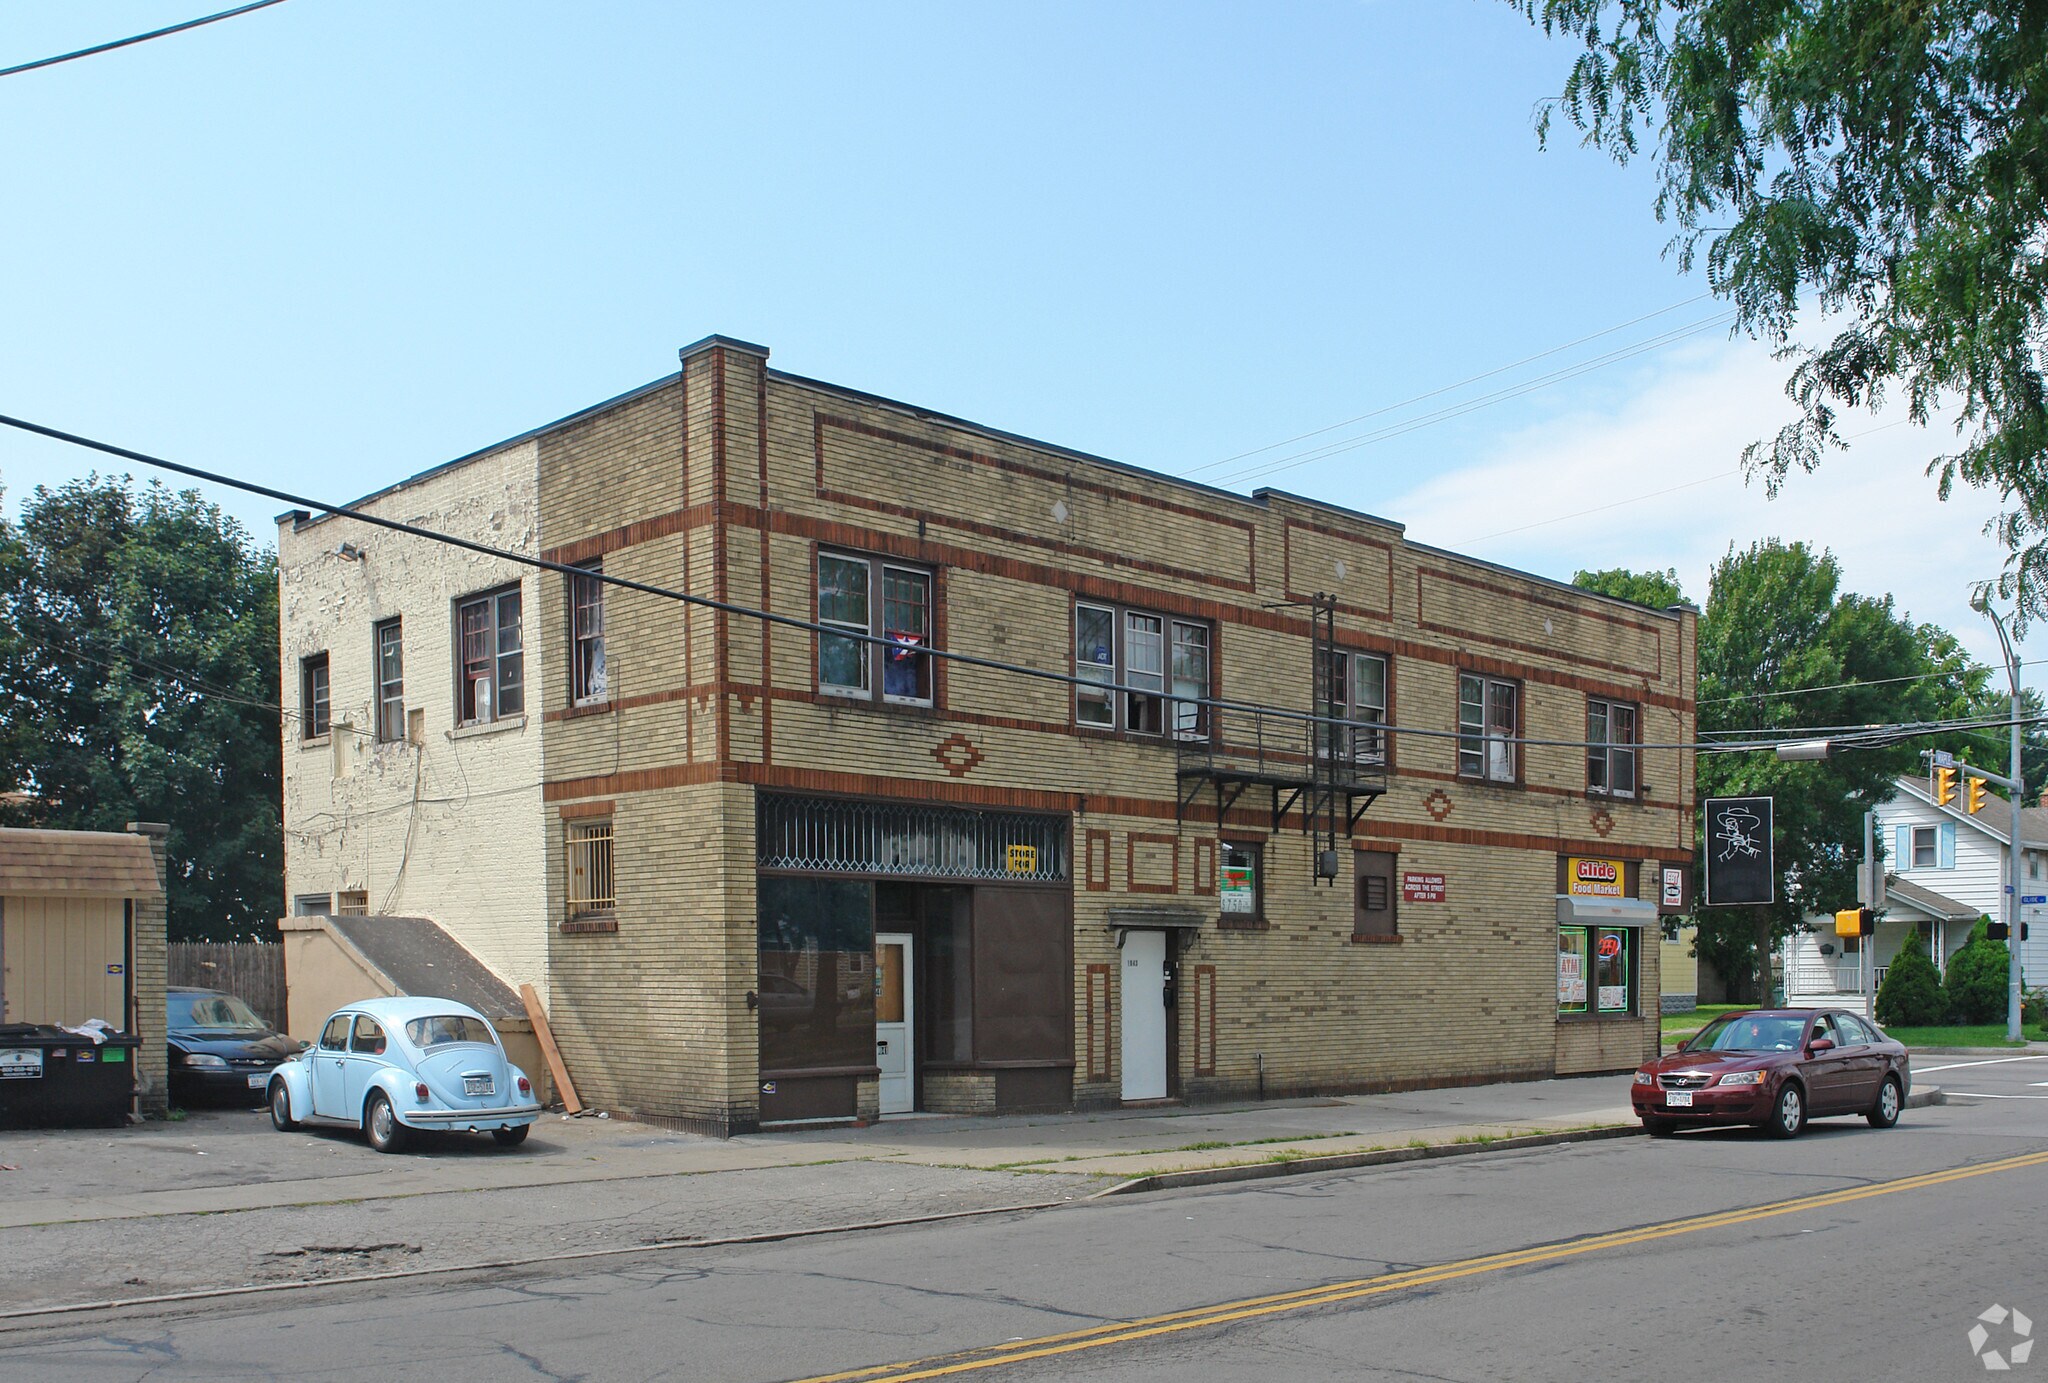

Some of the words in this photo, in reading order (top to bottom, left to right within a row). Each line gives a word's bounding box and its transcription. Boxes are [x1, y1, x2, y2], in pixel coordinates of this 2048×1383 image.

[1009, 849, 1035, 858] STORE
[1015, 859, 1030, 868] FOR
[1577, 860, 1616, 880] Glide
[1425, 876, 1442, 884] ALLOWED
[1573, 882, 1592, 894] Food
[1593, 883, 1620, 895] Market
[1561, 958, 1578, 974] ATM
